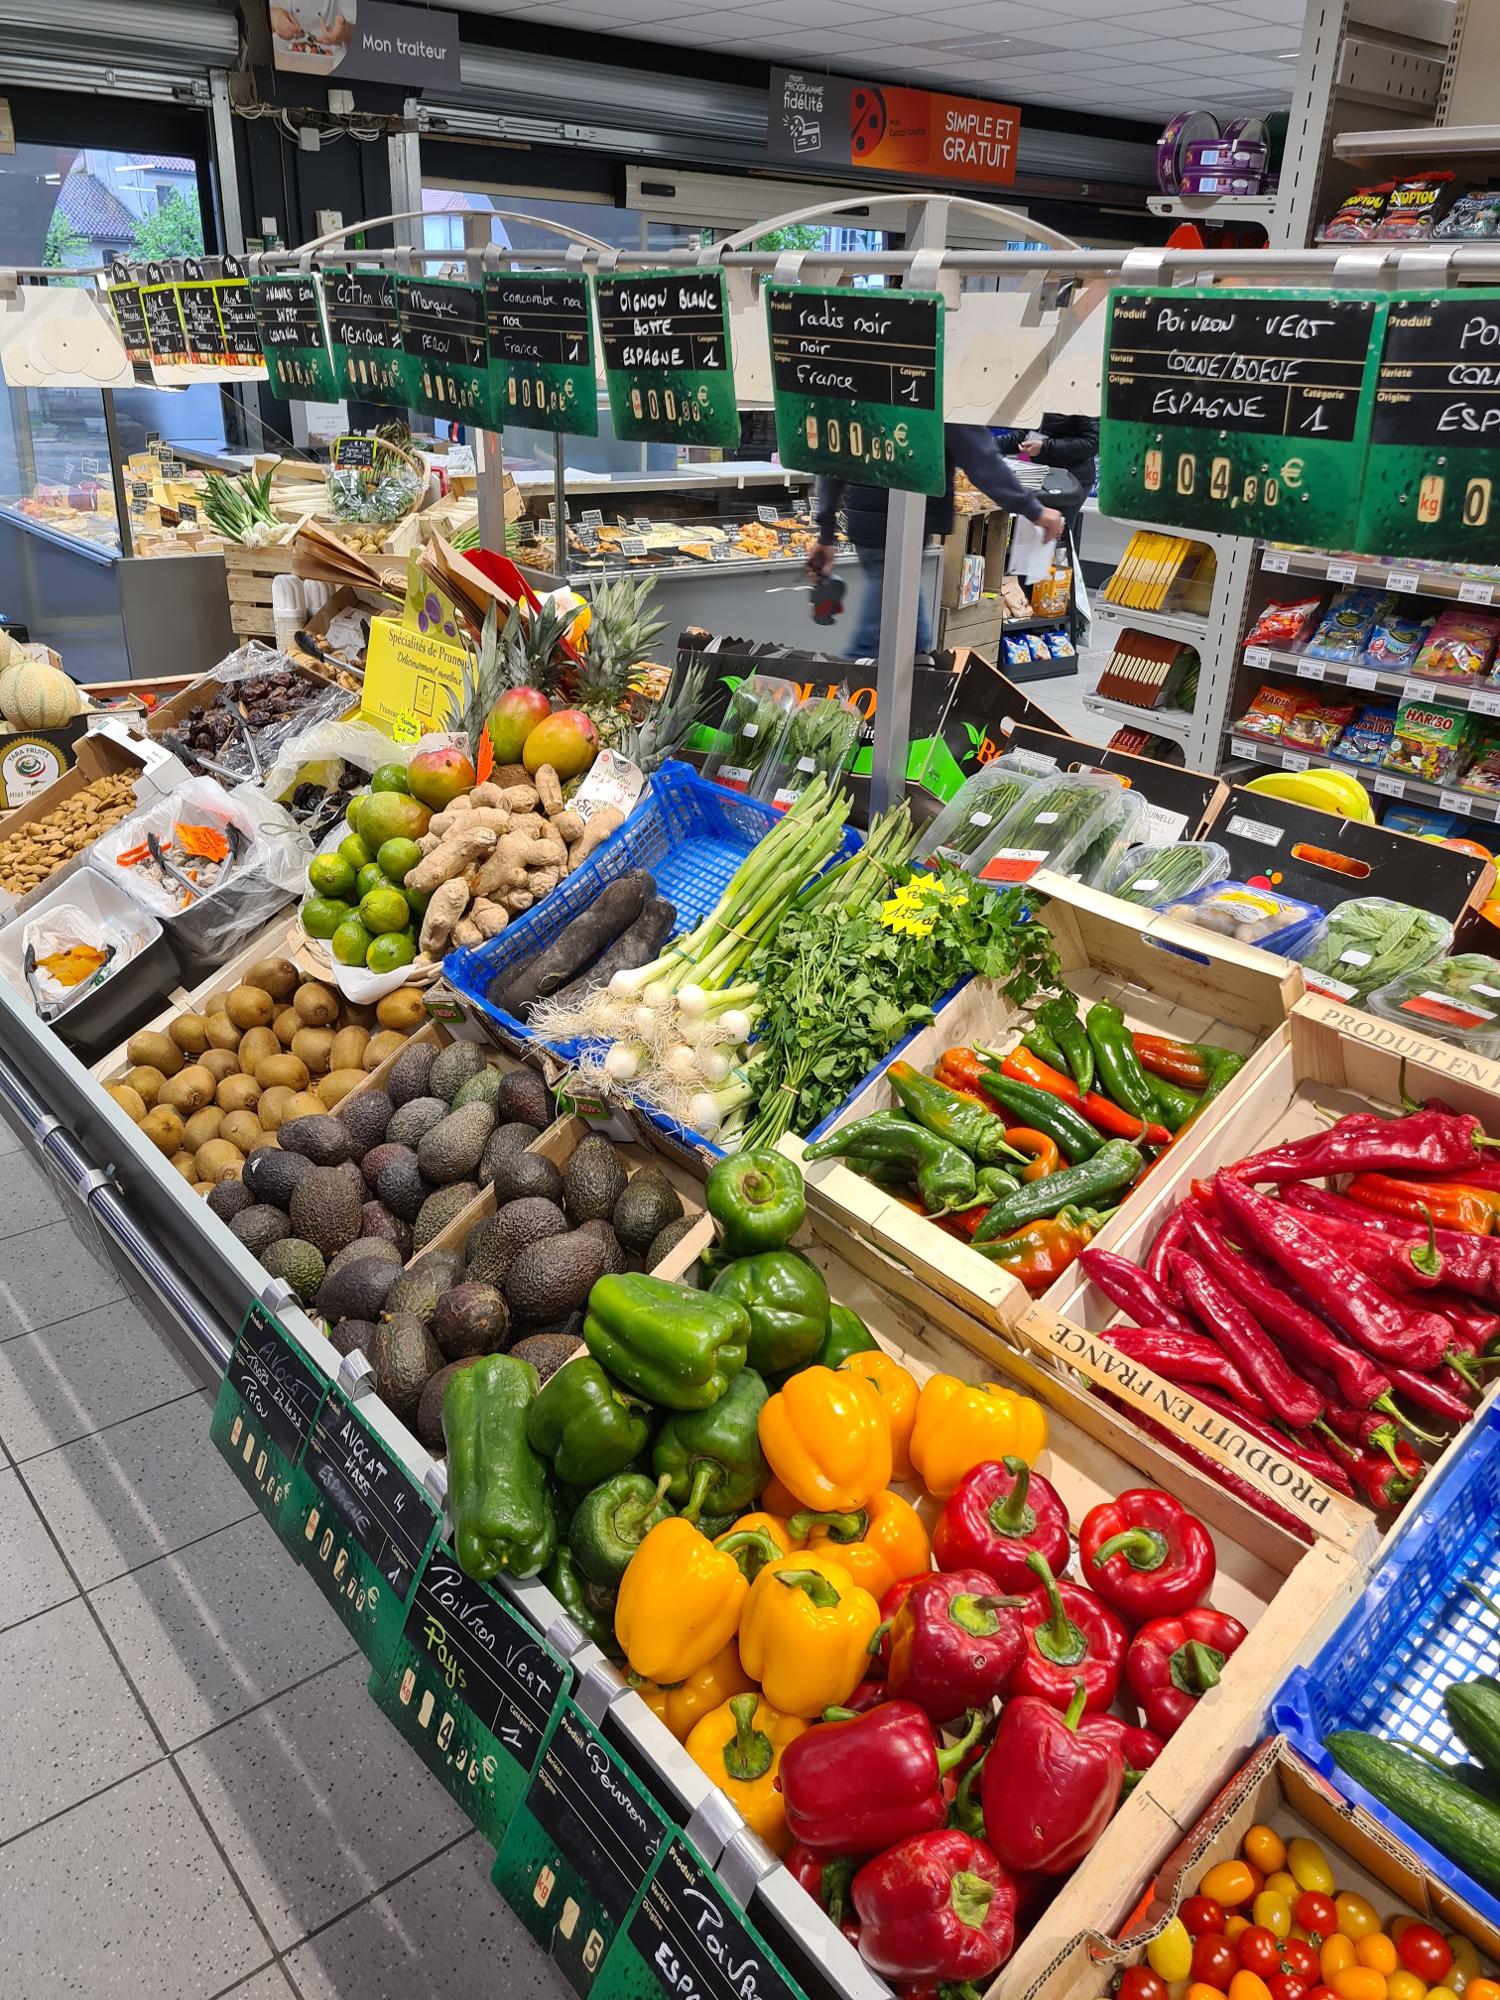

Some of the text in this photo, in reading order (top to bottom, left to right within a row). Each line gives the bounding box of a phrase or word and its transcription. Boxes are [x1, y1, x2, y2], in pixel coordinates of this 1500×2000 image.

[362, 33, 447, 60] Mon traiteur
[783, 92, 824, 113] fidélité
[945, 111, 991, 137] SIMPLE
[996, 119, 1013, 140] ET
[943, 137, 1011, 168] GRATUIT
[1342, 195, 1384, 209] TOPTOU
[678, 287, 718, 311] BLANC
[770, 301, 792, 310] Produit
[800, 299, 892, 335] radis noir
[1114, 308, 1147, 320] Produit
[1265, 314, 1337, 339] VERT
[1388, 315, 1433, 328] Produit
[1459, 316, 1500, 349] PO
[503, 335, 543, 358] France
[568, 342, 579, 361] 1
[622, 346, 685, 367] ESPAGNE
[702, 347, 720, 367] 1
[800, 340, 831, 355] noir
[796, 364, 858, 393] France
[1109, 375, 1135, 385] Origine
[1380, 368, 1414, 378] Variété
[901, 380, 920, 402] 1
[1152, 388, 1267, 419] ESPAGNE
[1302, 387, 1345, 400] Catégorie
[1376, 392, 1412, 403] Origine
[1299, 404, 1330, 433] 1
[1420, 493, 1439, 516] kg
[388, 627, 427, 655] Spécialités
[427, 642, 438, 658] de
[1405, 708, 1454, 731] HARIBO
[7, 747, 50, 763] YARA FRUITS
[1321, 1008, 1489, 1081] PRODUIT EN
[258, 1341, 319, 1404] AVOCAT
[1049, 1322, 1332, 1516] PRODUIT EN FRANCE
[339, 1420, 389, 1483] AVOCAT
[344, 1454, 373, 1497] HASS
[387, 1565, 401, 1586] 1
[423, 1615, 467, 1689] Pays
[509, 1705, 534, 1734] Catégorie
[500, 1725, 522, 1749] 1
[560, 1716, 585, 1750] Produit
[545, 1752, 563, 1778] Variété
[538, 1770, 557, 1796] Origine
[668, 1847, 697, 1886] Produit
[650, 1882, 671, 1913] Variété
[642, 1900, 664, 1932] Origine
